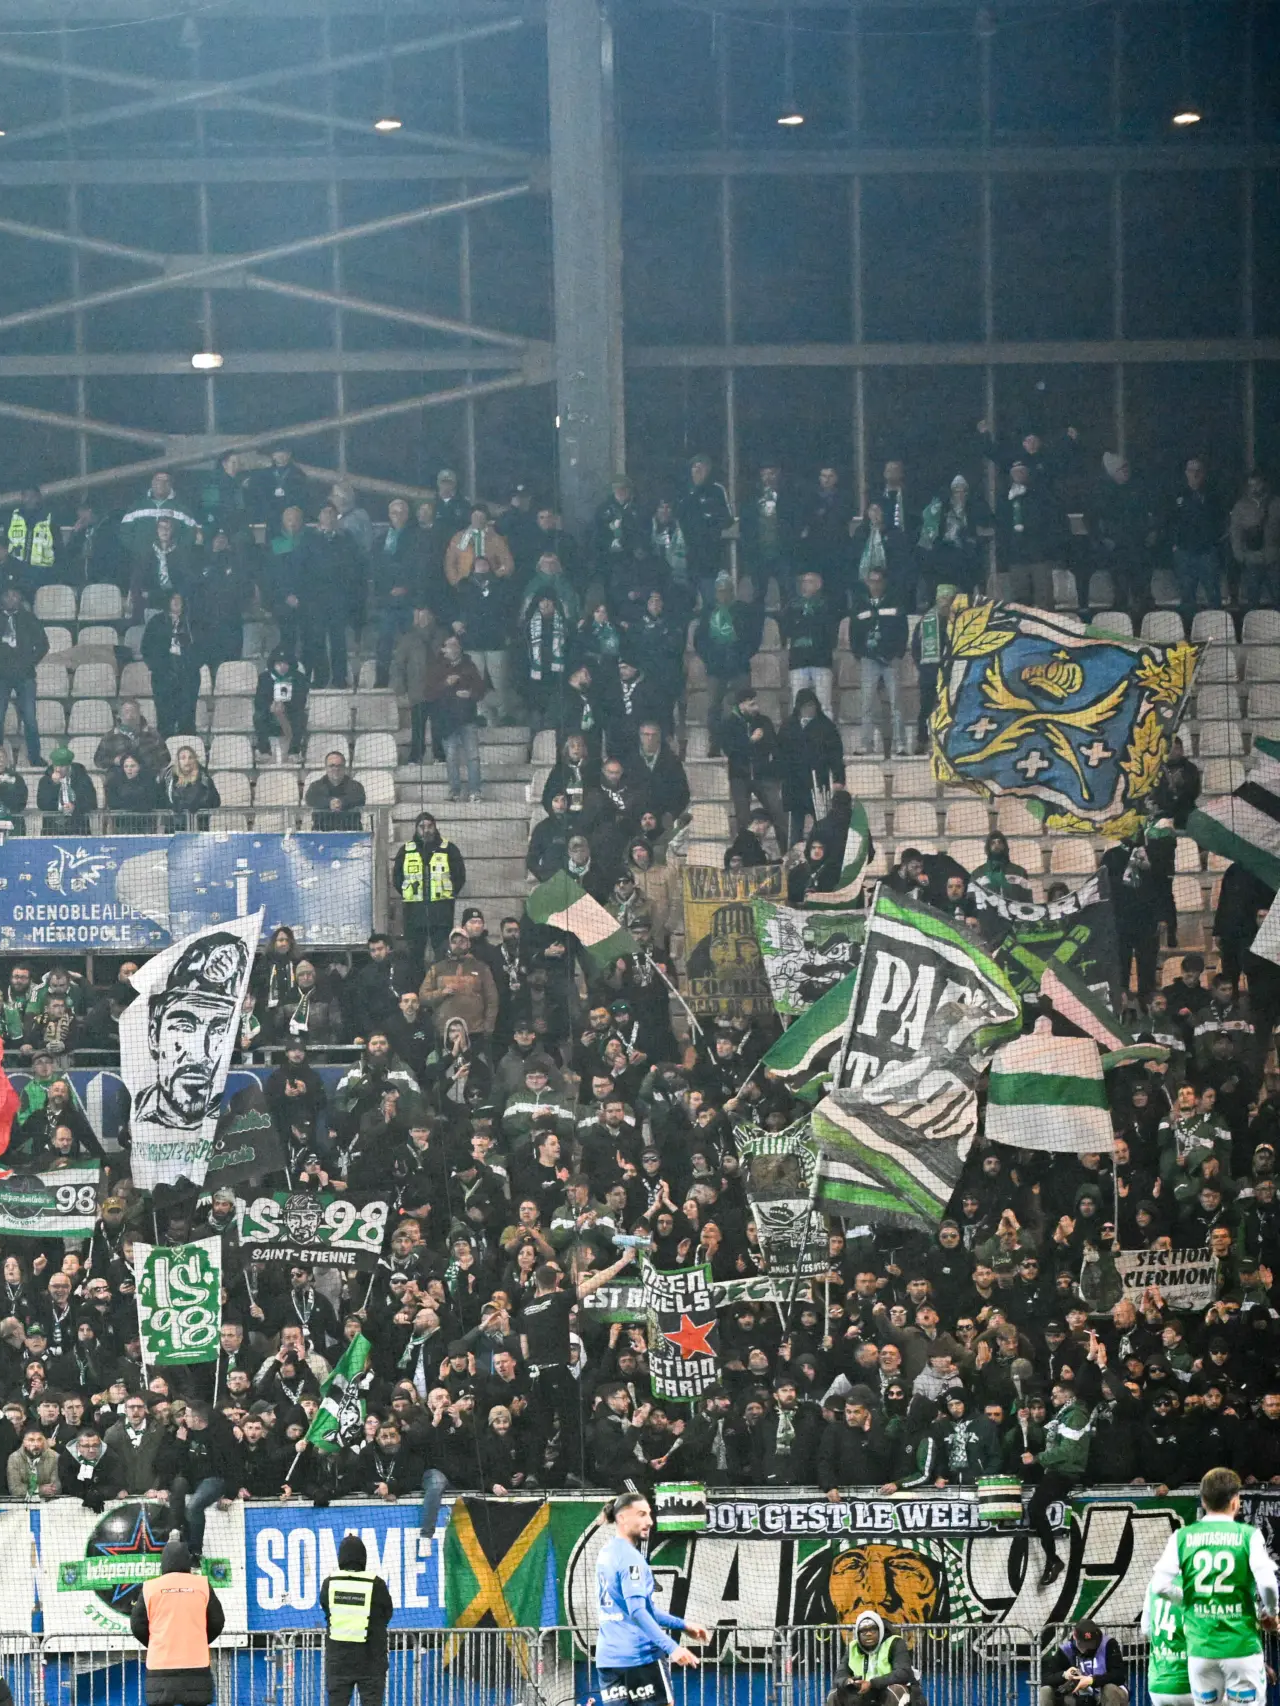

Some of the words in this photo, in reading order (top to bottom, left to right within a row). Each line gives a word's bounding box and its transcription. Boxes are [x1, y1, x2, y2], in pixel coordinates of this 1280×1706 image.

[32, 922, 131, 943] MÉTROPOLE
[55, 1185, 97, 1214] 98
[324, 1200, 389, 1246] 98
[252, 1248, 357, 1264] SAINT-ETIENNE
[1136, 1247, 1212, 1267] SECTION
[154, 1256, 210, 1308] IS
[1124, 1267, 1217, 1289] CLERMON
[150, 1306, 218, 1350] 98
[649, 1352, 716, 1377] ECTION
[857, 1503, 892, 1529] LE
[1193, 1550, 1236, 1594] 22
[1154, 1598, 1177, 1640] 14
[628, 1683, 656, 1701] LCR
